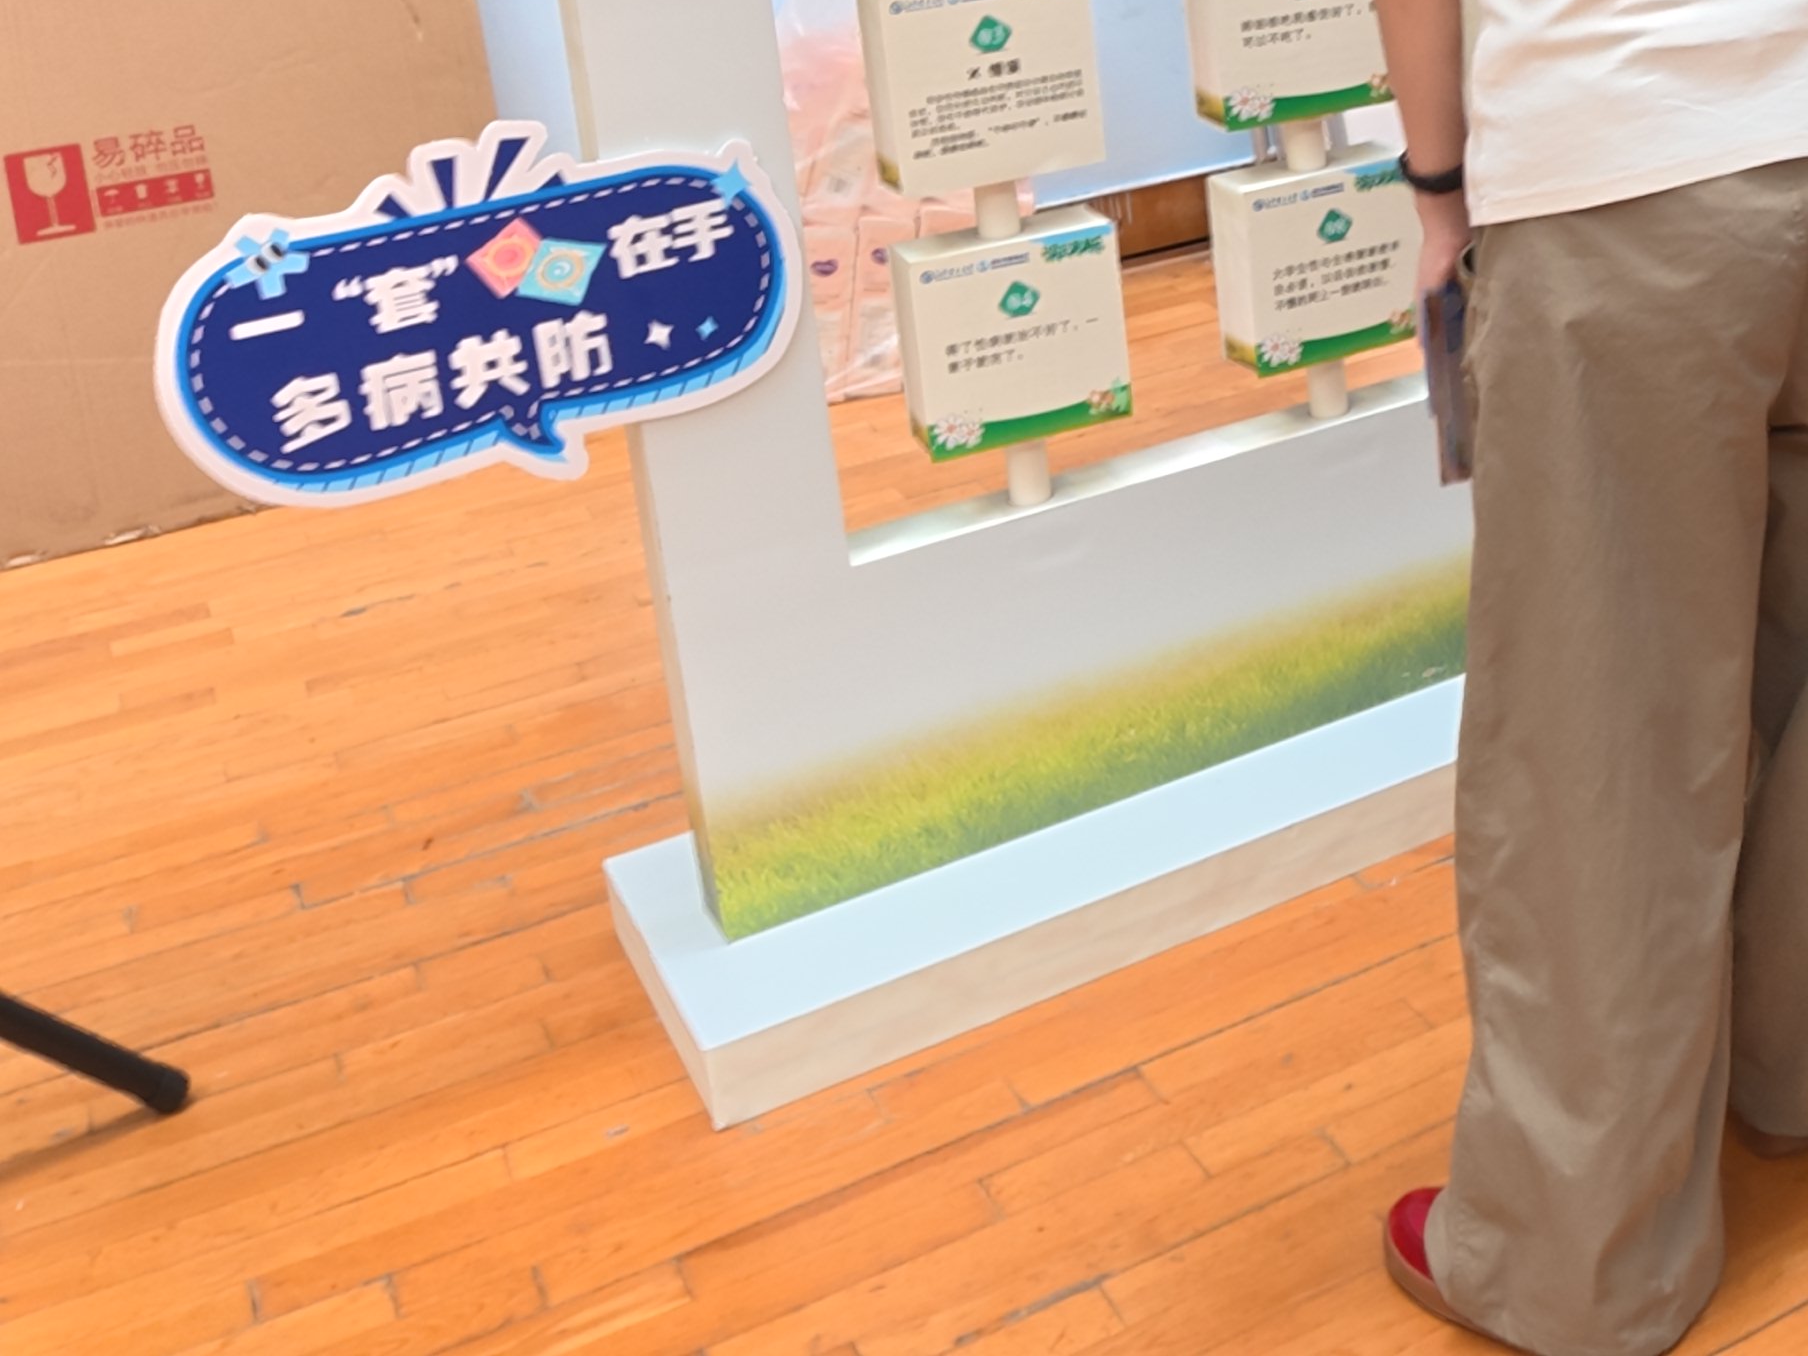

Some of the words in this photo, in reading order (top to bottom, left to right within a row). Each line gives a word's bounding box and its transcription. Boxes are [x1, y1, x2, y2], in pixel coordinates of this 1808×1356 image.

[92, 124, 206, 169] 易碎品
[271, 310, 614, 455] 多病共防
